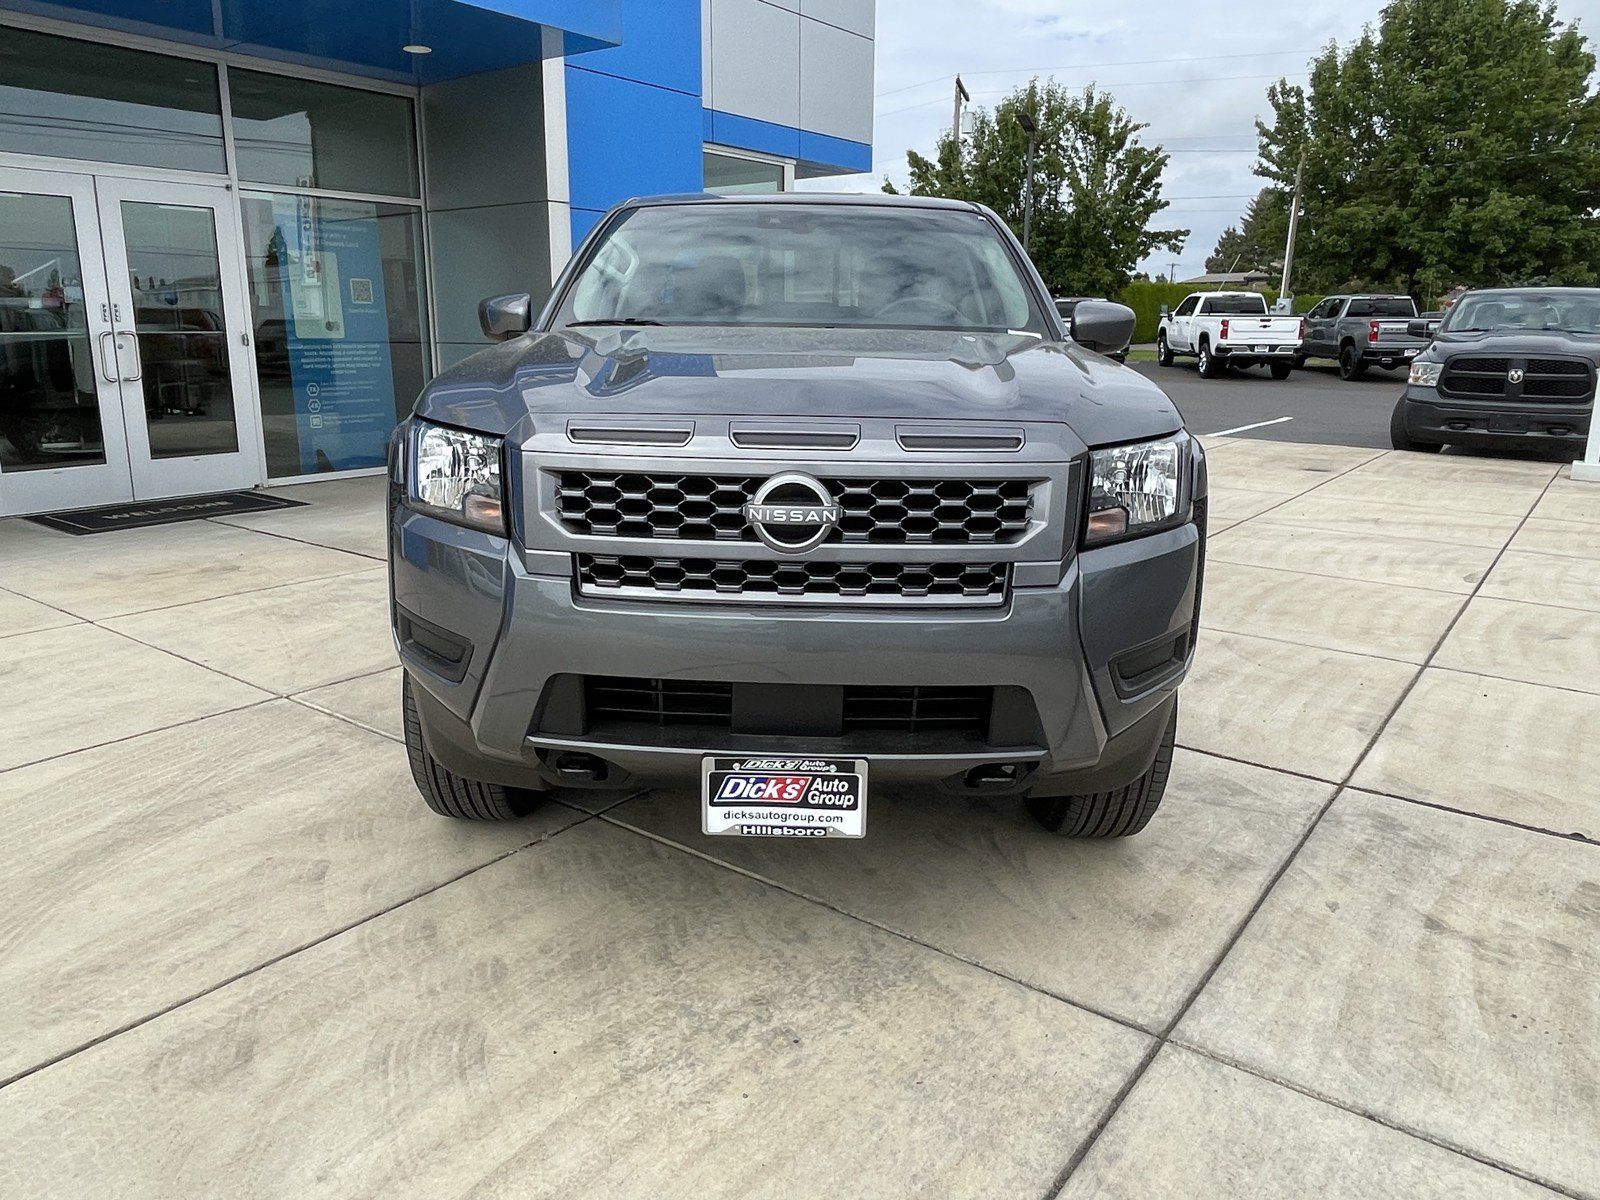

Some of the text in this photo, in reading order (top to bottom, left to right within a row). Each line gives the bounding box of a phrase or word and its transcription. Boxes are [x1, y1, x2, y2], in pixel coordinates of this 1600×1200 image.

[749, 508, 836, 522] NISSAN
[720, 777, 801, 800] Dick's
[810, 777, 849, 793] Auto
[807, 791, 855, 808] Group
[723, 810, 843, 823] dicksautogroup.com
[742, 826, 825, 836] Hillsboro
